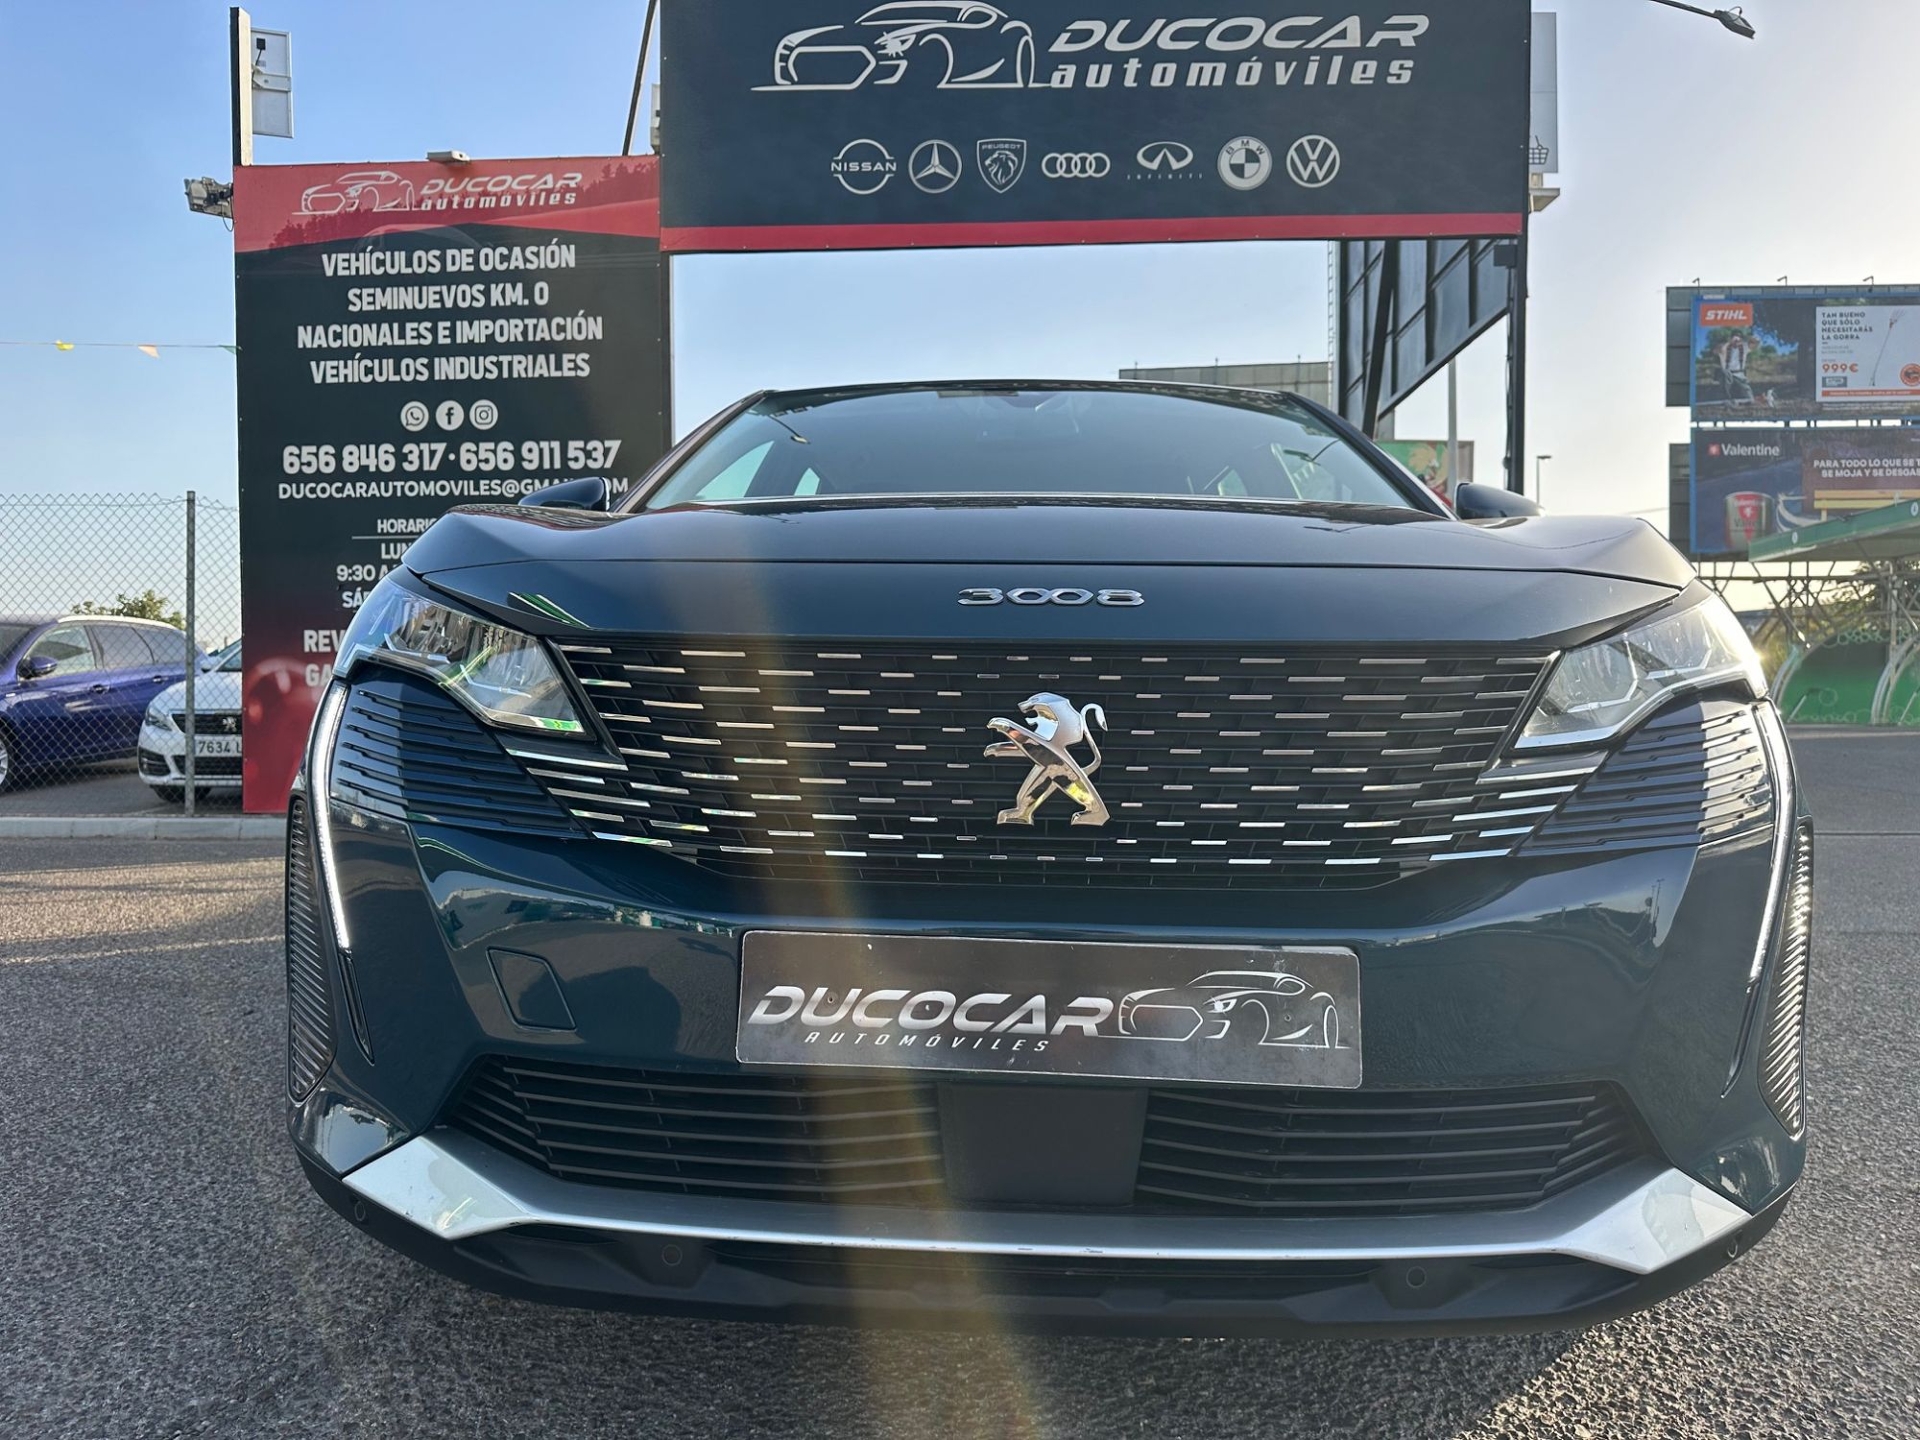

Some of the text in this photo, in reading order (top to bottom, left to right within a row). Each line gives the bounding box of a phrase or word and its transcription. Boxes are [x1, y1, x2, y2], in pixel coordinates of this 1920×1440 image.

[1048, 14, 1429, 52] DUCOCAR
[1051, 55, 1415, 89] automóviles
[831, 161, 897, 172] NISSAN
[420, 173, 582, 195] DUCOCAR
[322, 238, 576, 277] VEHÍCULOS DE OCASIÓN
[347, 284, 485, 312] SEMINUEVOS
[490, 282, 529, 307] KM.
[1705, 309, 1748, 320] STIHL
[297, 310, 602, 349] NACIONALES E IMPORTACIÓN
[310, 352, 590, 384] VEHÍCULOS INDUSTRIALES
[283, 444, 336, 474] 656
[342, 443, 396, 473] 846
[459, 441, 515, 472] 656
[521, 440, 562, 470] 911
[567, 439, 622, 470] 537
[1721, 443, 1780, 456] Valentine
[1813, 459, 1839, 468] PARA
[1841, 459, 1867, 468] TODO
[1868, 459, 1881, 467] LO
[1882, 458, 1901, 467] QUE
[1902, 458, 1914, 467] SE
[1821, 469, 1834, 478] SE
[1835, 469, 1862, 477] MOJA
[1864, 469, 1871, 477] Y
[1872, 468, 1884, 476] SE
[336, 564, 376, 581] 9:30
[957, 587, 1145, 606] 3008
[198, 741, 231, 754] 7634
[747, 985, 1114, 1036] DUCOCAR
[804, 1031, 1050, 1052] AUTOMÓVILES
